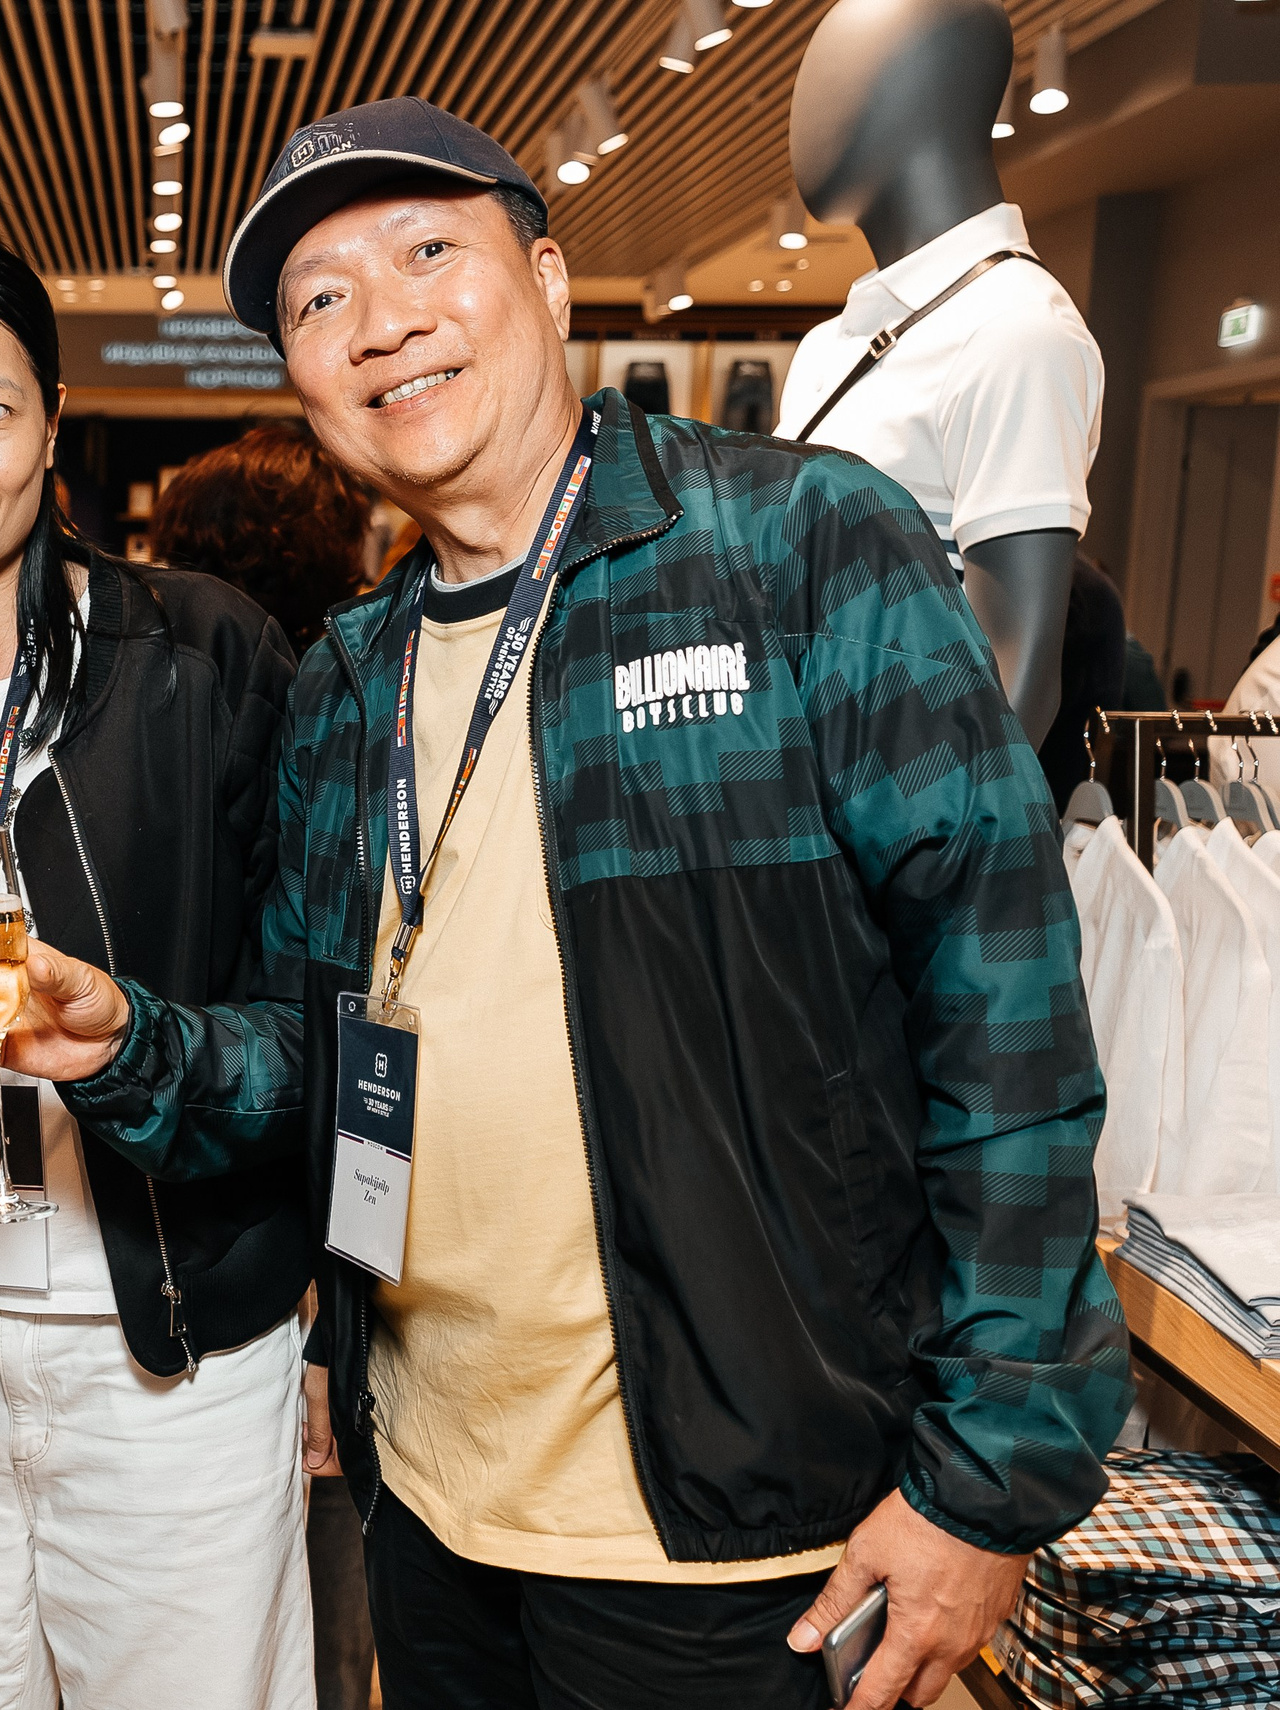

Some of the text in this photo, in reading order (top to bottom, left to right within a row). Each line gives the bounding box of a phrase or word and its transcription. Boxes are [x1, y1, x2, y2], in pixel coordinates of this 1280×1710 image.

[484, 626, 516, 700] OF MEN'S STYLE
[493, 632, 527, 700] 30 YEARS
[615, 641, 750, 710] BILLIONAIRE
[396, 778, 412, 873] HENDERSON
[358, 1079, 401, 1101] HENDERSON
[368, 1098, 388, 1111] 30 YEARS
[363, 1189, 377, 1205] Zen
